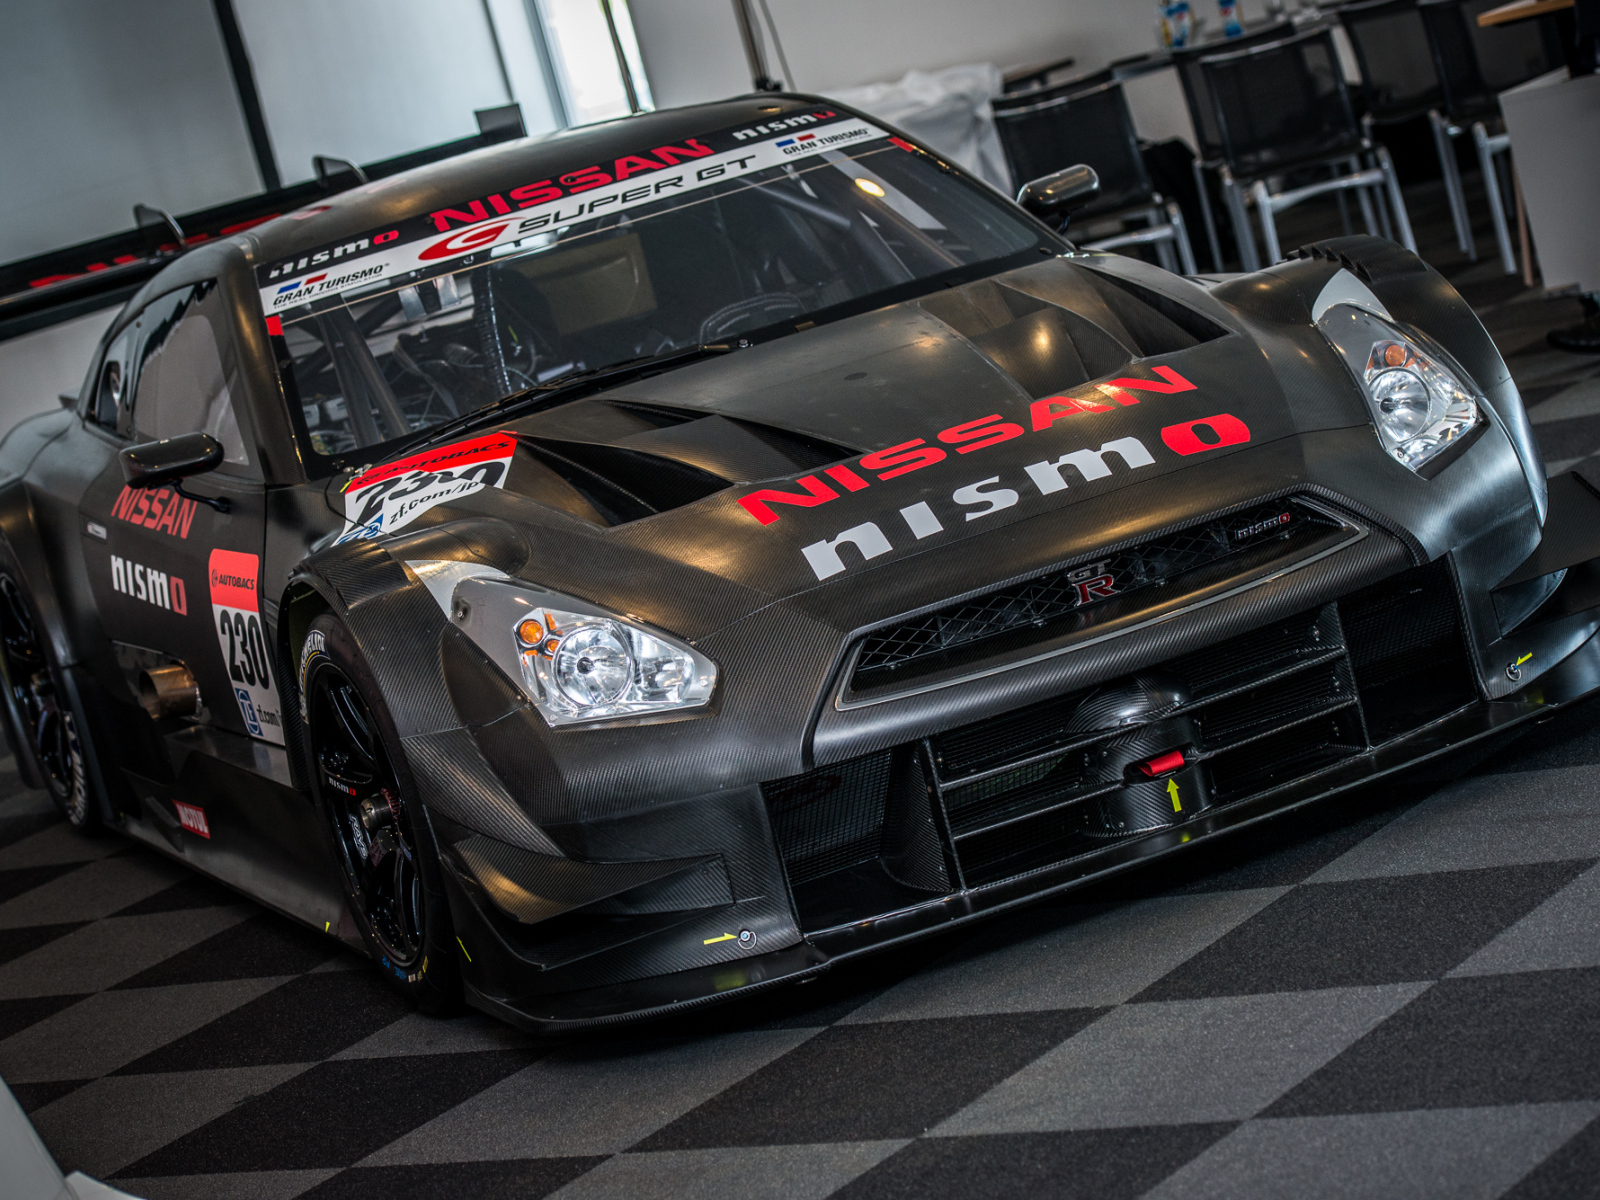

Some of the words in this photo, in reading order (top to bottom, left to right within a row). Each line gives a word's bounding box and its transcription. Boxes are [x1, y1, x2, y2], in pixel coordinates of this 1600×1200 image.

[731, 111, 836, 140] nismo
[783, 141, 818, 155] GRAN
[817, 128, 869, 146] TURISMO
[429, 138, 716, 232] NISSAN
[518, 175, 684, 234] SUPER
[697, 155, 757, 181] GT
[269, 230, 399, 278] nismo
[273, 286, 315, 306] GRAN
[318, 264, 384, 291] TURISMO
[383, 440, 511, 475] AUTOBACS
[736, 365, 1198, 527] NISSAN
[111, 484, 198, 540] NISSAN
[345, 461, 506, 535] 230
[389, 481, 480, 525] zf.com/jp
[801, 413, 1251, 581] nismo
[1235, 512, 1290, 540] nismo
[110, 554, 188, 616] nismo
[219, 573, 255, 590] AUTOBACS
[1067, 557, 1112, 583] GT
[1074, 573, 1122, 608] R
[219, 609, 270, 690] 230
[328, 776, 356, 796] nismo
